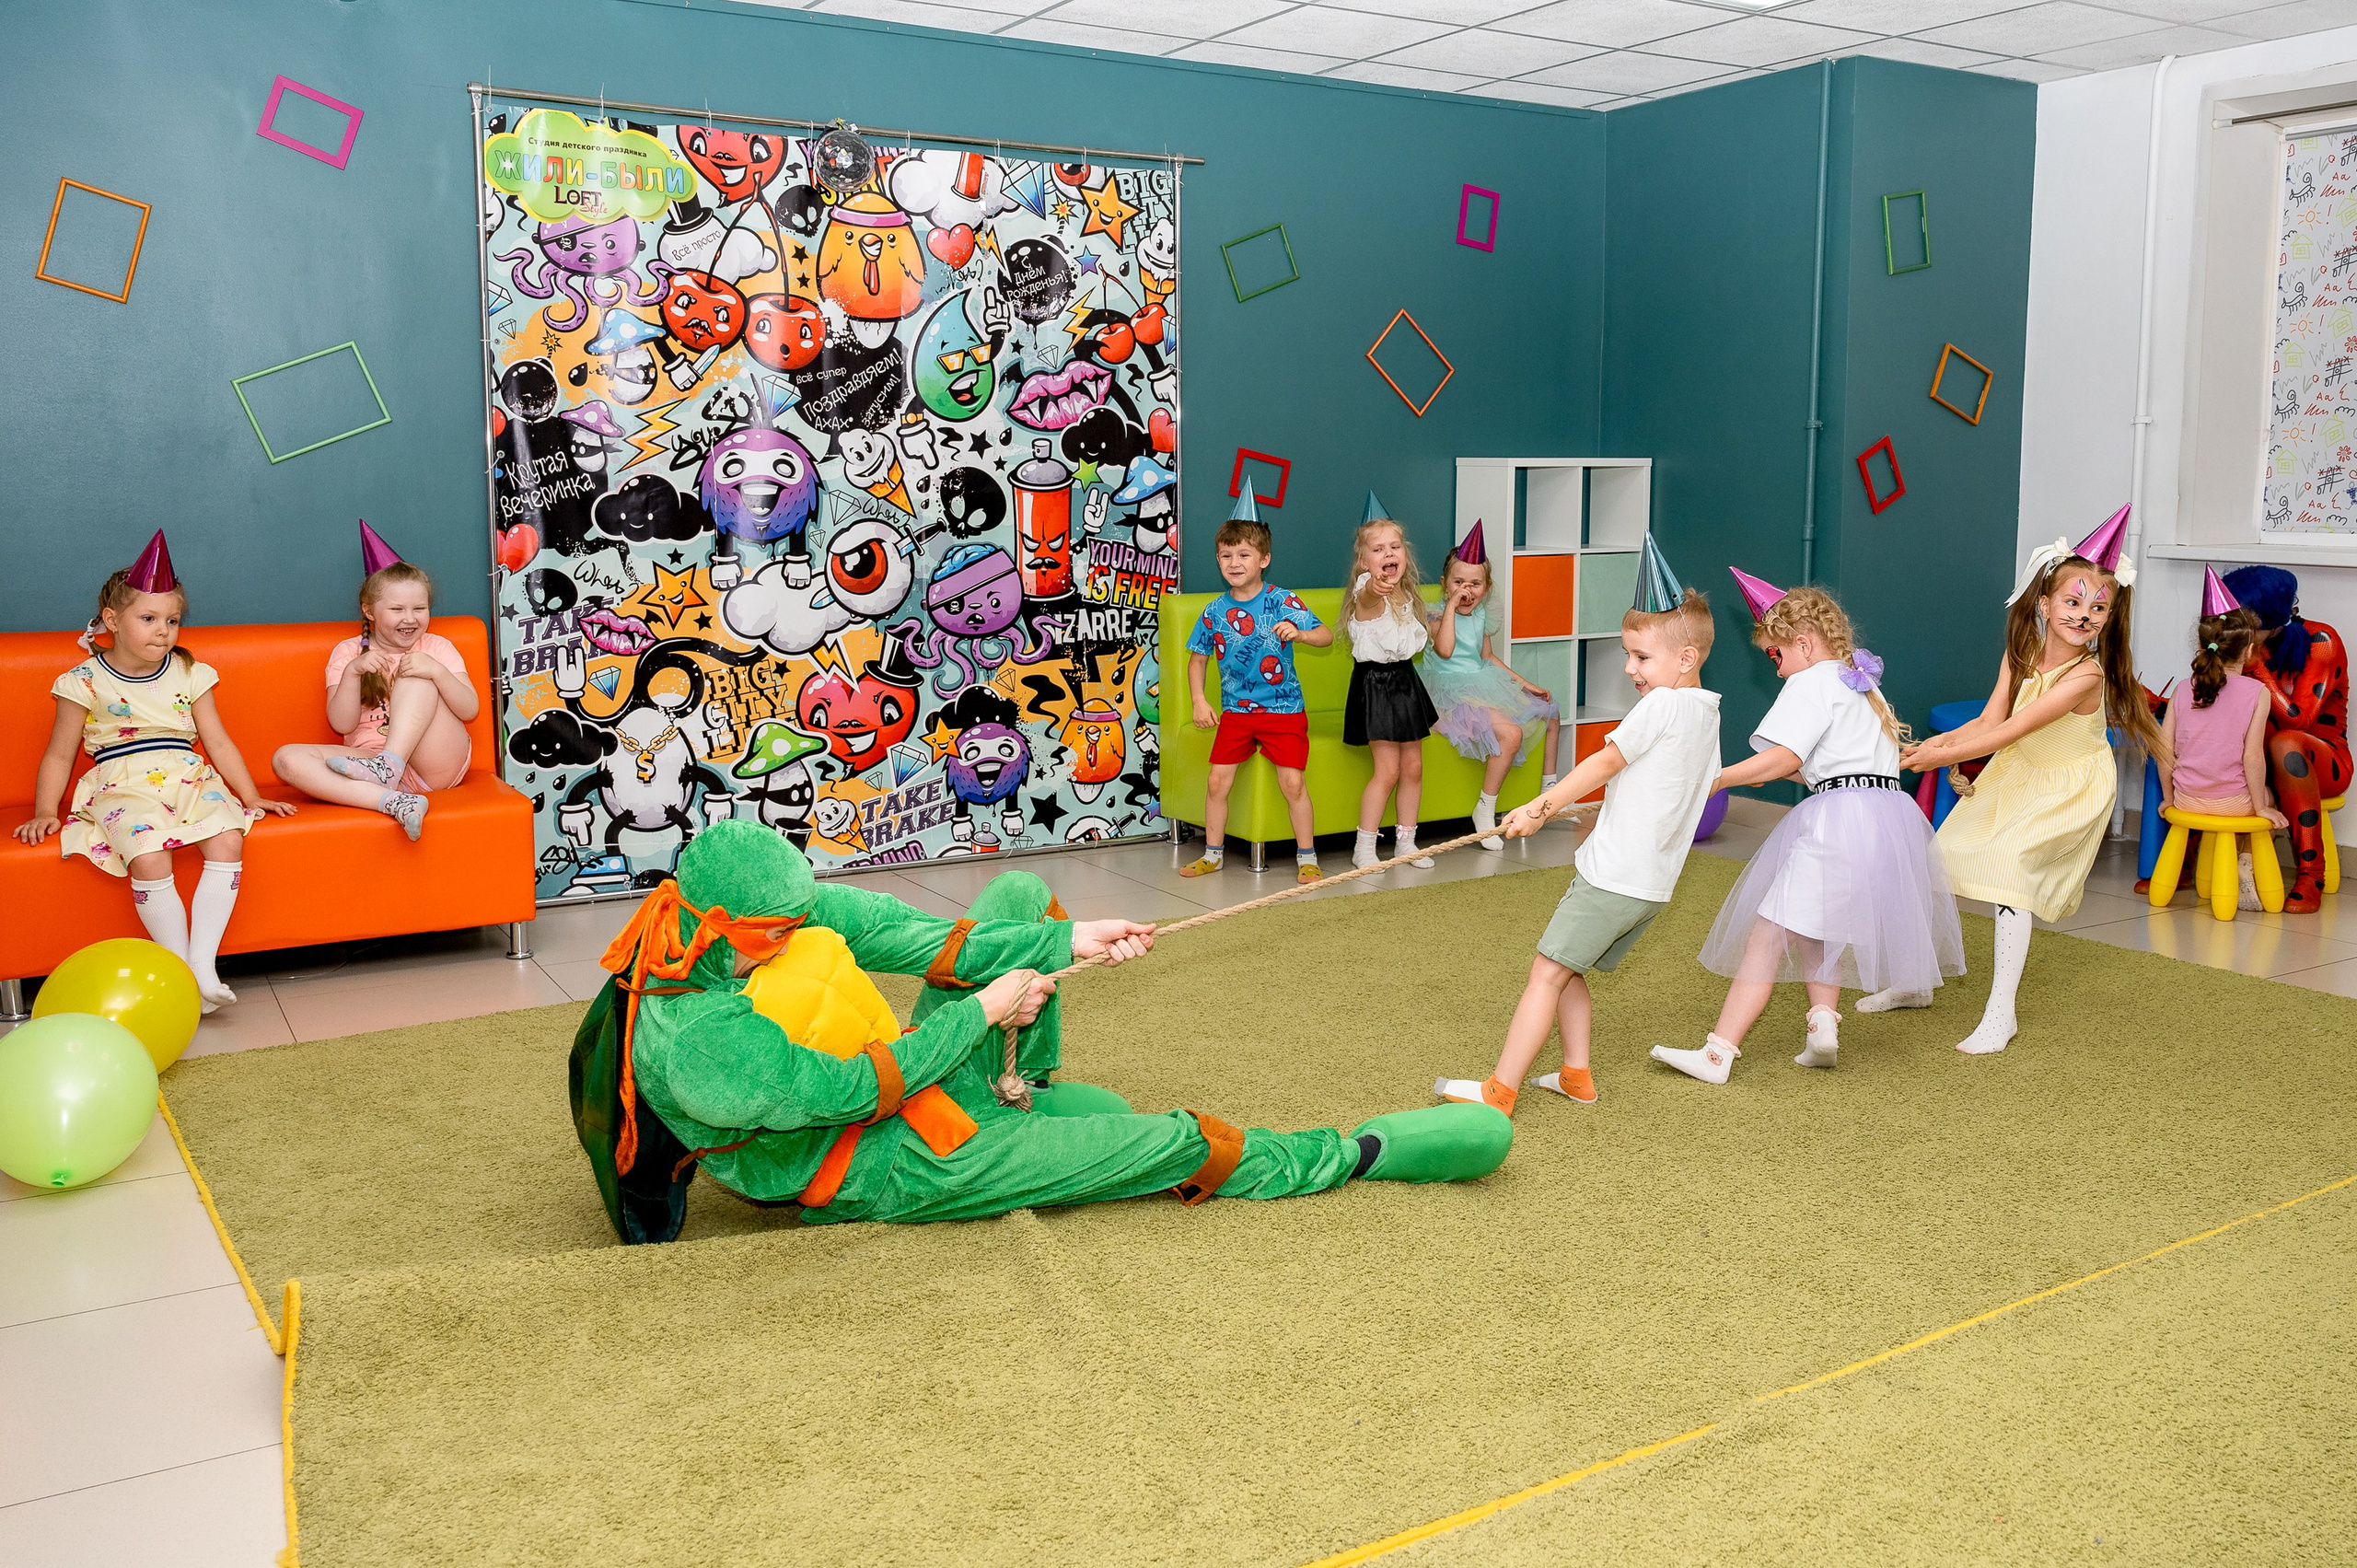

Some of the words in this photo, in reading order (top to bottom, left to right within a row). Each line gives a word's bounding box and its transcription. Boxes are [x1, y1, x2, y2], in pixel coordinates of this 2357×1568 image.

[528, 136, 561, 147] Студия
[562, 142, 601, 152] детского
[603, 146, 647, 158] праздника
[494, 149, 685, 194] ЖИЛИ-БЫЛИ
[1116, 169, 1171, 201] BIG
[553, 186, 603, 207] LOFT
[579, 201, 609, 218] Style
[691, 230, 722, 250] просто
[1014, 265, 1046, 287] Днём
[816, 366, 847, 380] супер
[505, 450, 569, 491] Крутая
[1089, 540, 1136, 573] YOUR
[1136, 552, 1178, 579] MIND
[1086, 564, 1110, 600] IS
[517, 597, 615, 645] TAK
[704, 659, 777, 701] BIG
[702, 683, 789, 730] CITY
[861, 776, 944, 825] TAKE
[856, 798, 958, 854] BRAKE
